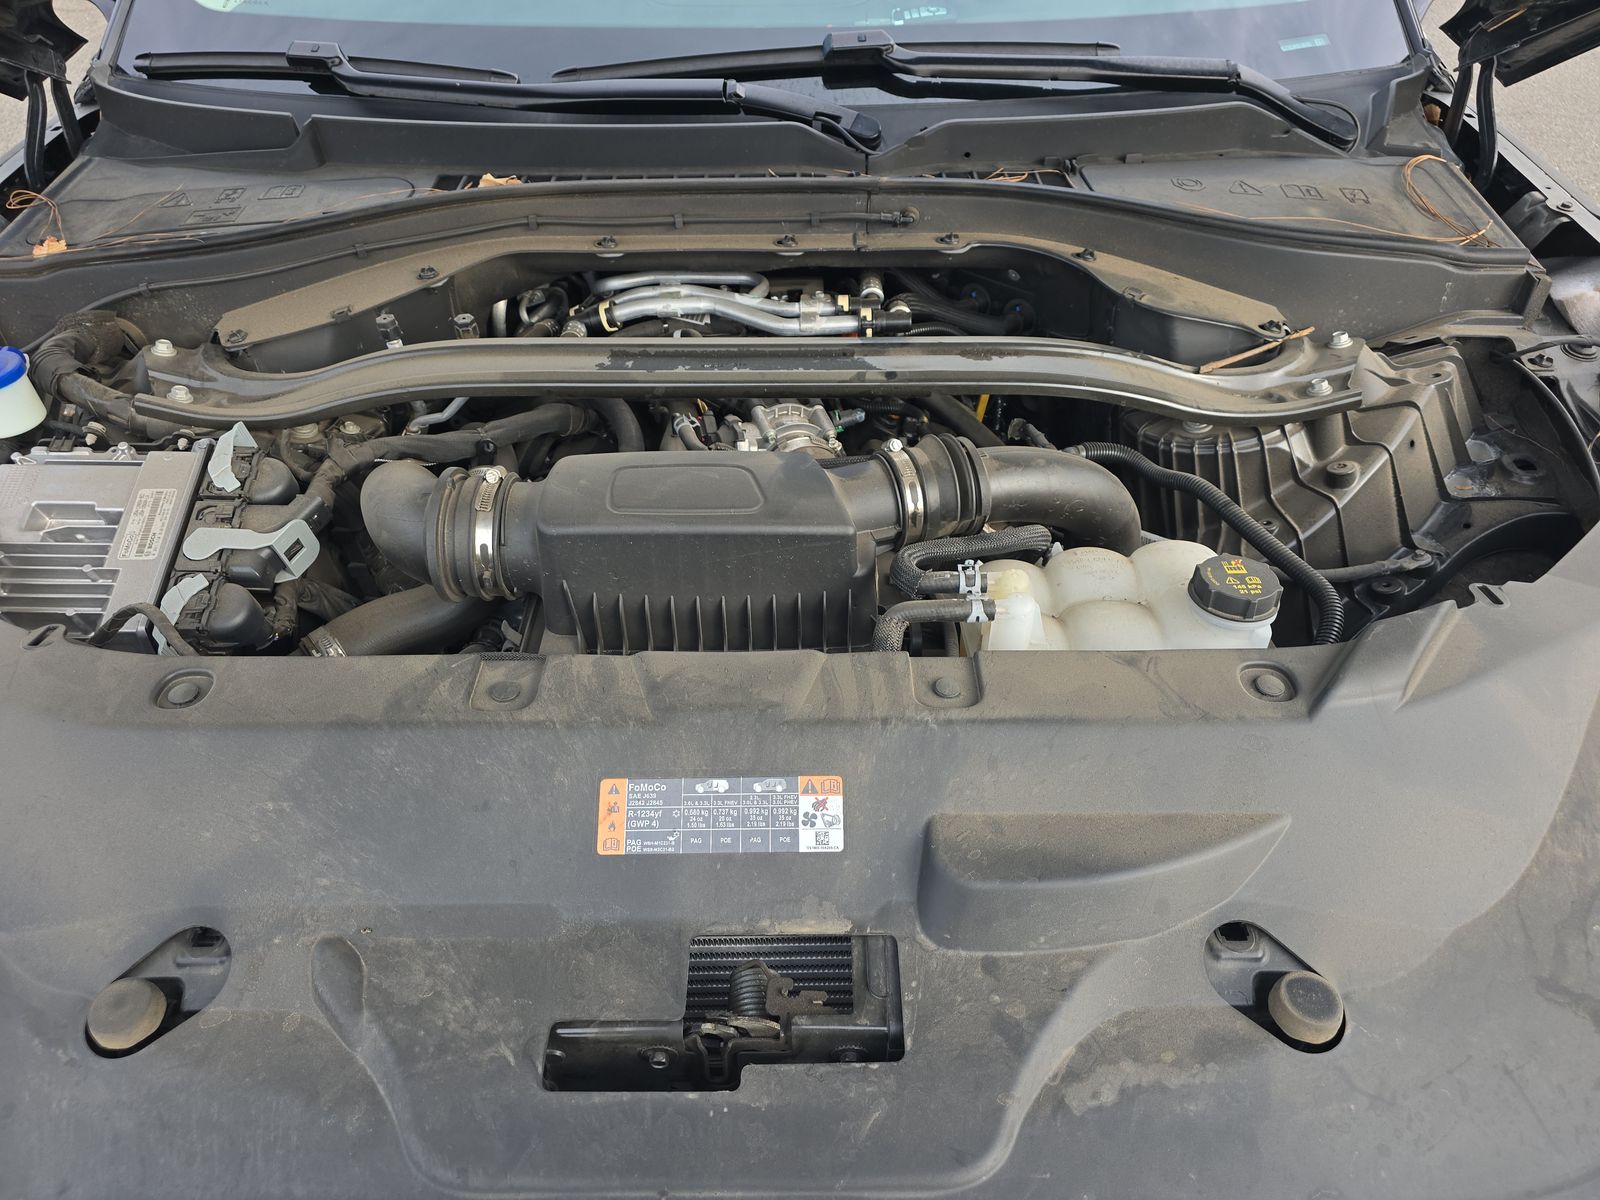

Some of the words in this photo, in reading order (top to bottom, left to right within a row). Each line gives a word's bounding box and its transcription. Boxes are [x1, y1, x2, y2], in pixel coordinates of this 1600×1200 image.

[147, 532, 157, 550] BOSCH
[628, 783, 666, 792] FoMoCo
[628, 810, 662, 819] R-1234yf
[627, 820, 650, 829] (GWP
[651, 820, 659, 828] 4)
